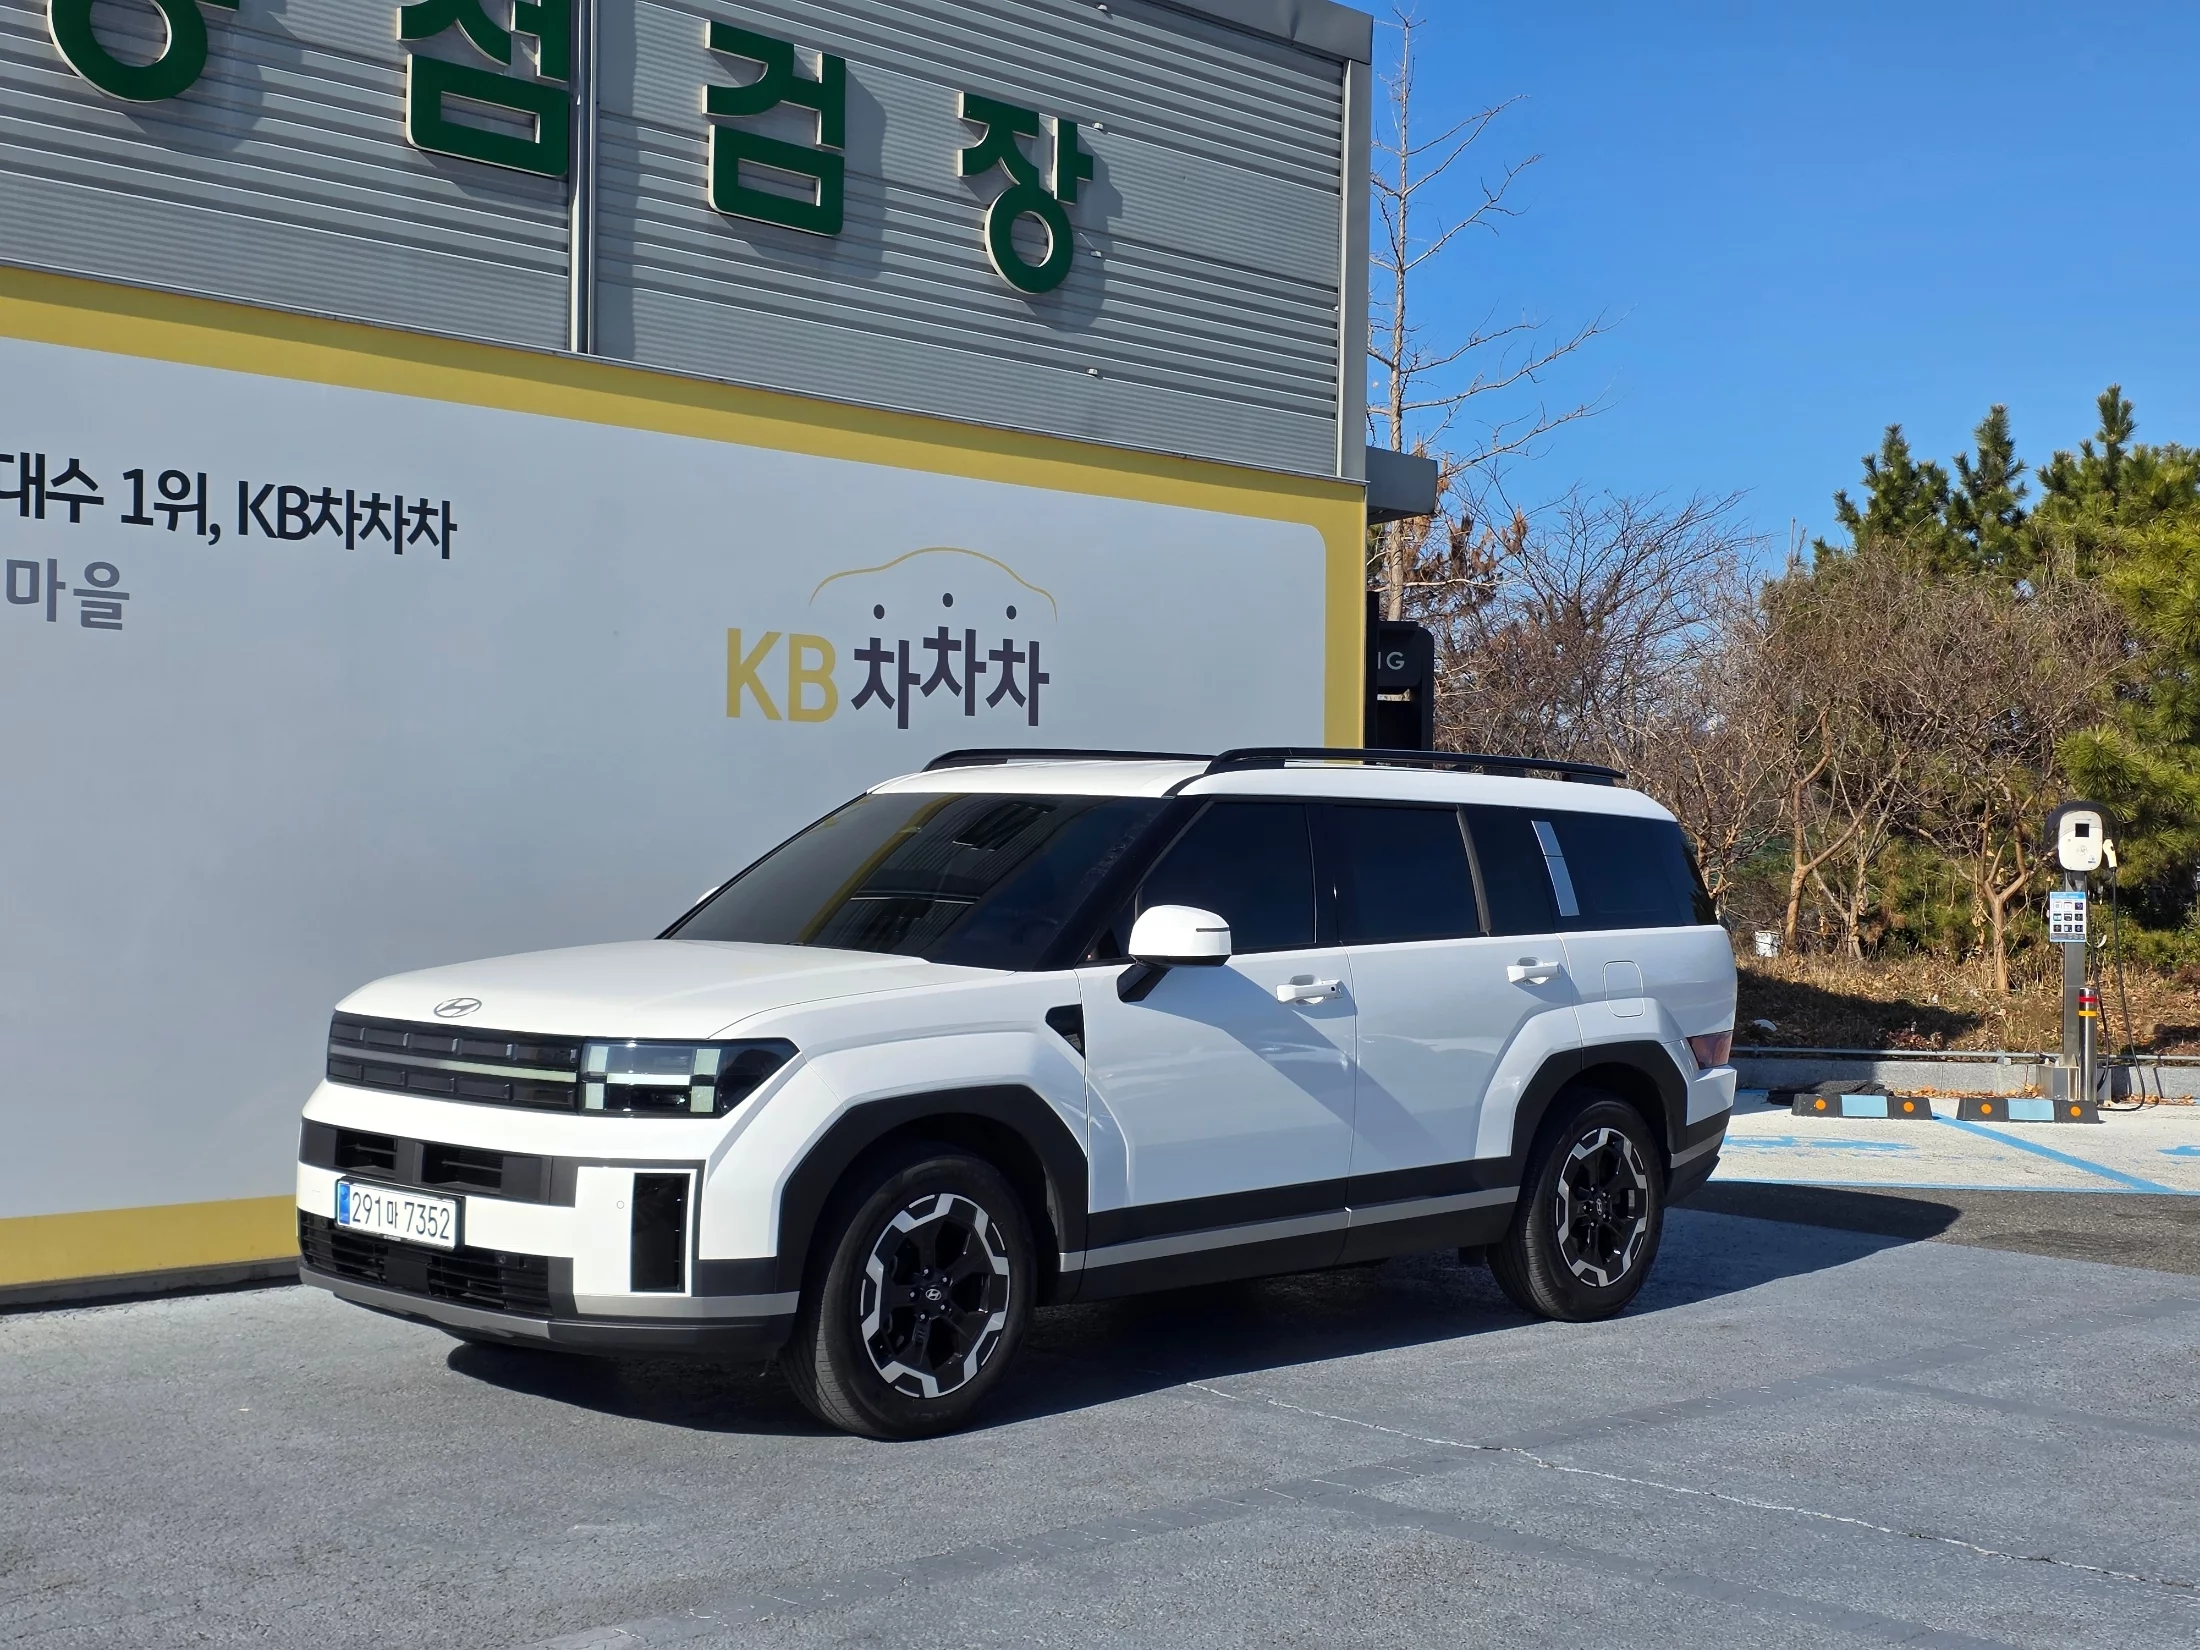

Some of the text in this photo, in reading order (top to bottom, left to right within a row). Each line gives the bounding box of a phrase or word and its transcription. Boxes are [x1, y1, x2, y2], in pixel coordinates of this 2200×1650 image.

[0, 452, 458, 560] 대수 1위, KB차차차
[6, 557, 130, 630] 마을
